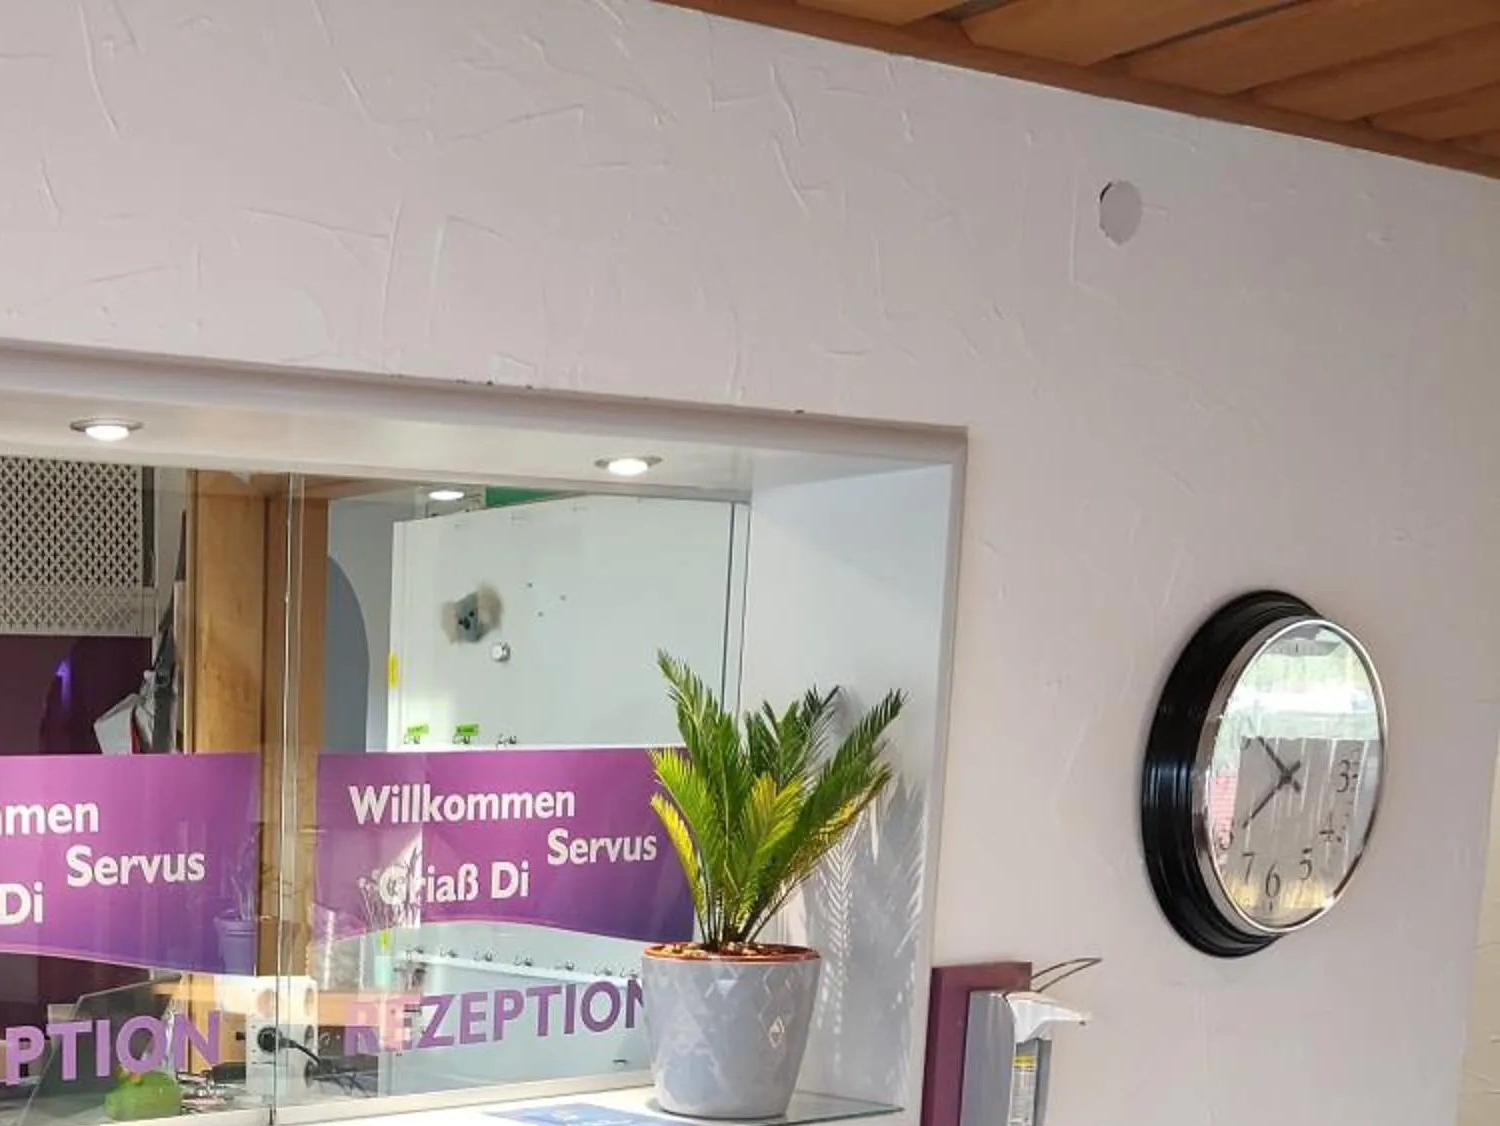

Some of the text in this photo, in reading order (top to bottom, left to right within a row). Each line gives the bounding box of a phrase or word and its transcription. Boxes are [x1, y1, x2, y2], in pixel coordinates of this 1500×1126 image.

[349, 784, 575, 824] Willkommen
[66, 845, 205, 887] Servus
[547, 828, 657, 865] Servus
[379, 861, 530, 905] Griaß Di
[1265, 861, 1281, 898] 6
